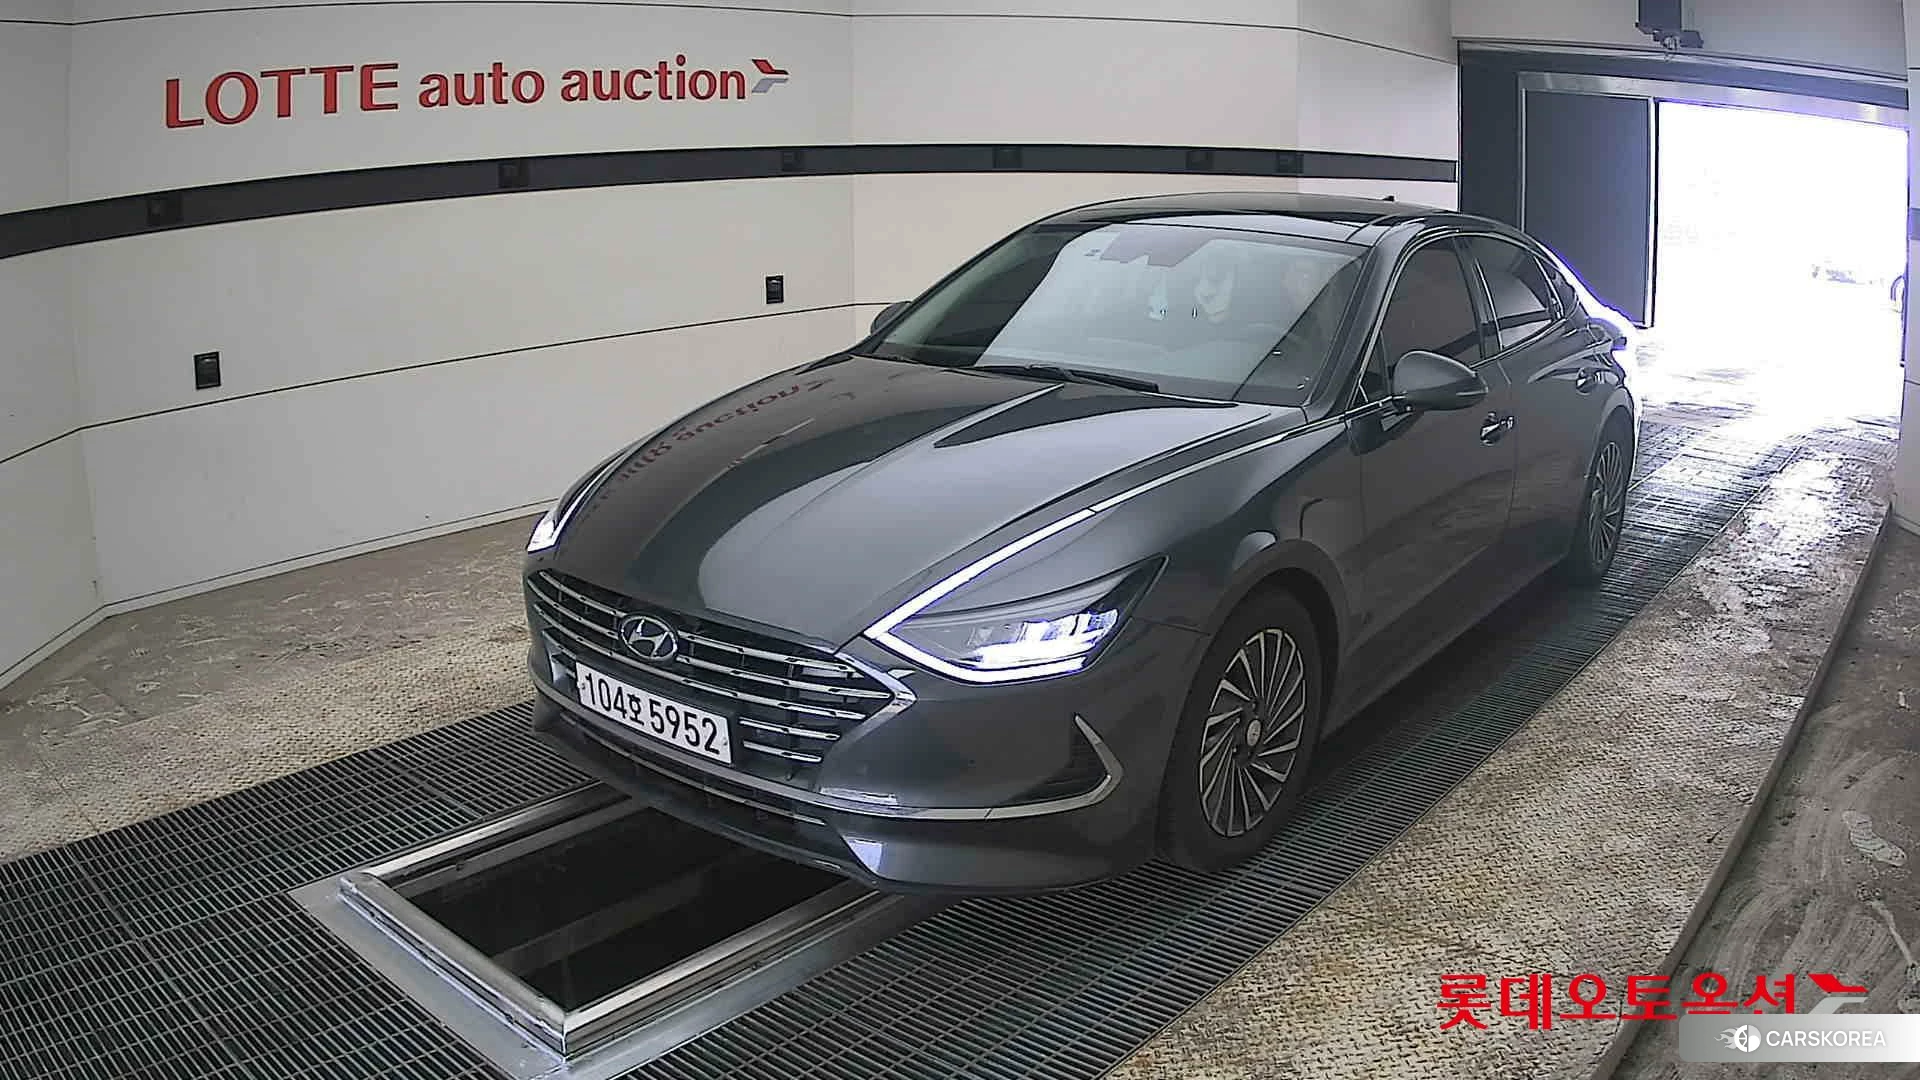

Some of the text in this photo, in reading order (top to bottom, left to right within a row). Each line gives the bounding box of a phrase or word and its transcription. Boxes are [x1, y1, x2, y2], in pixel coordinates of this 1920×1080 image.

[165, 54, 747, 129] LOTTE auto auction
